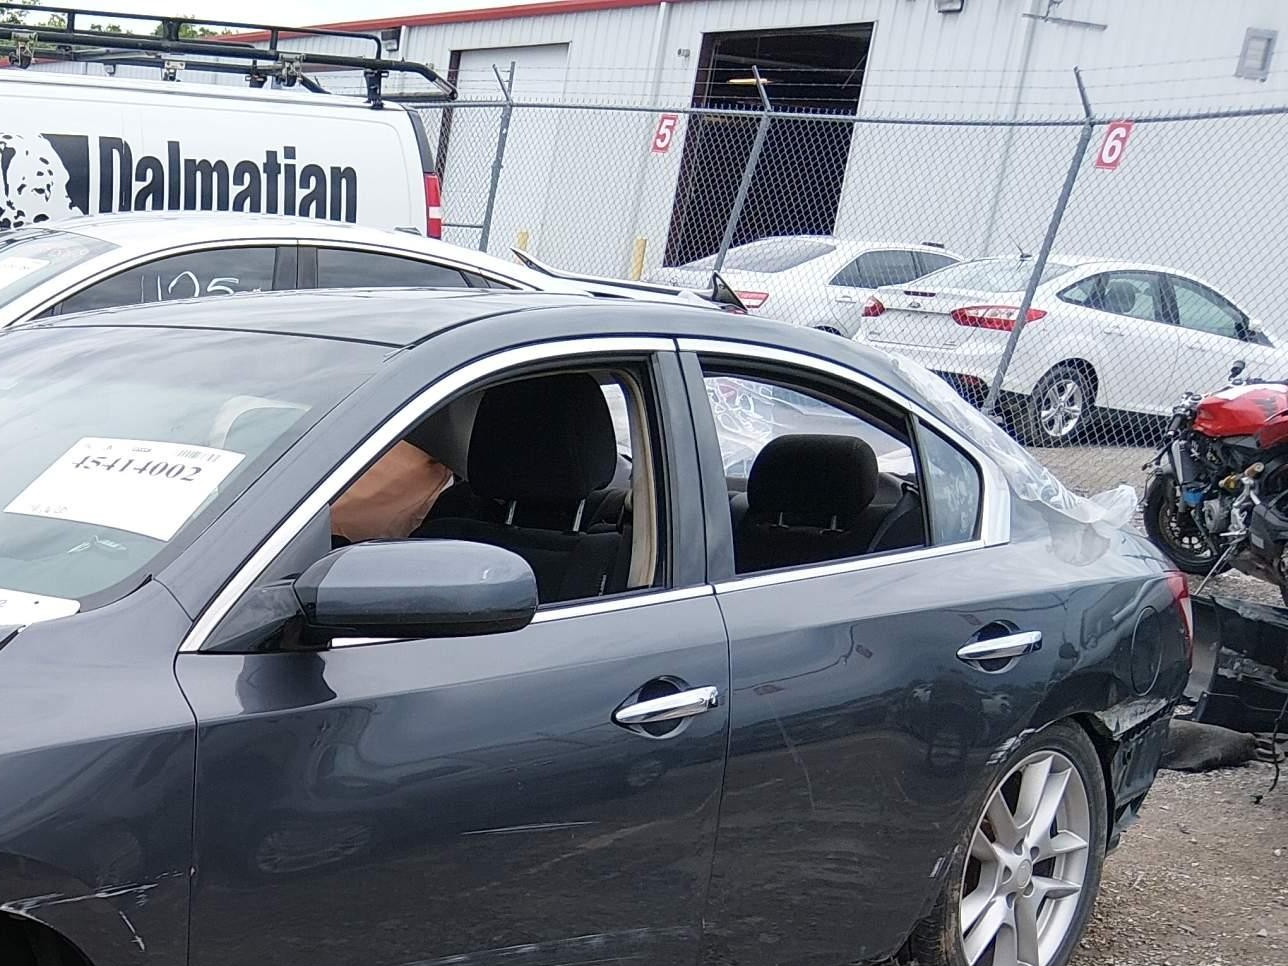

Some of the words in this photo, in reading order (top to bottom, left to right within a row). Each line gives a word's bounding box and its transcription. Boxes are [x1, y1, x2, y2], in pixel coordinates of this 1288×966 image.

[656, 119, 675, 148] 5
[1102, 127, 1126, 164] 6
[99, 136, 357, 224] Dalmatian
[72, 456, 202, 481] 45414002
